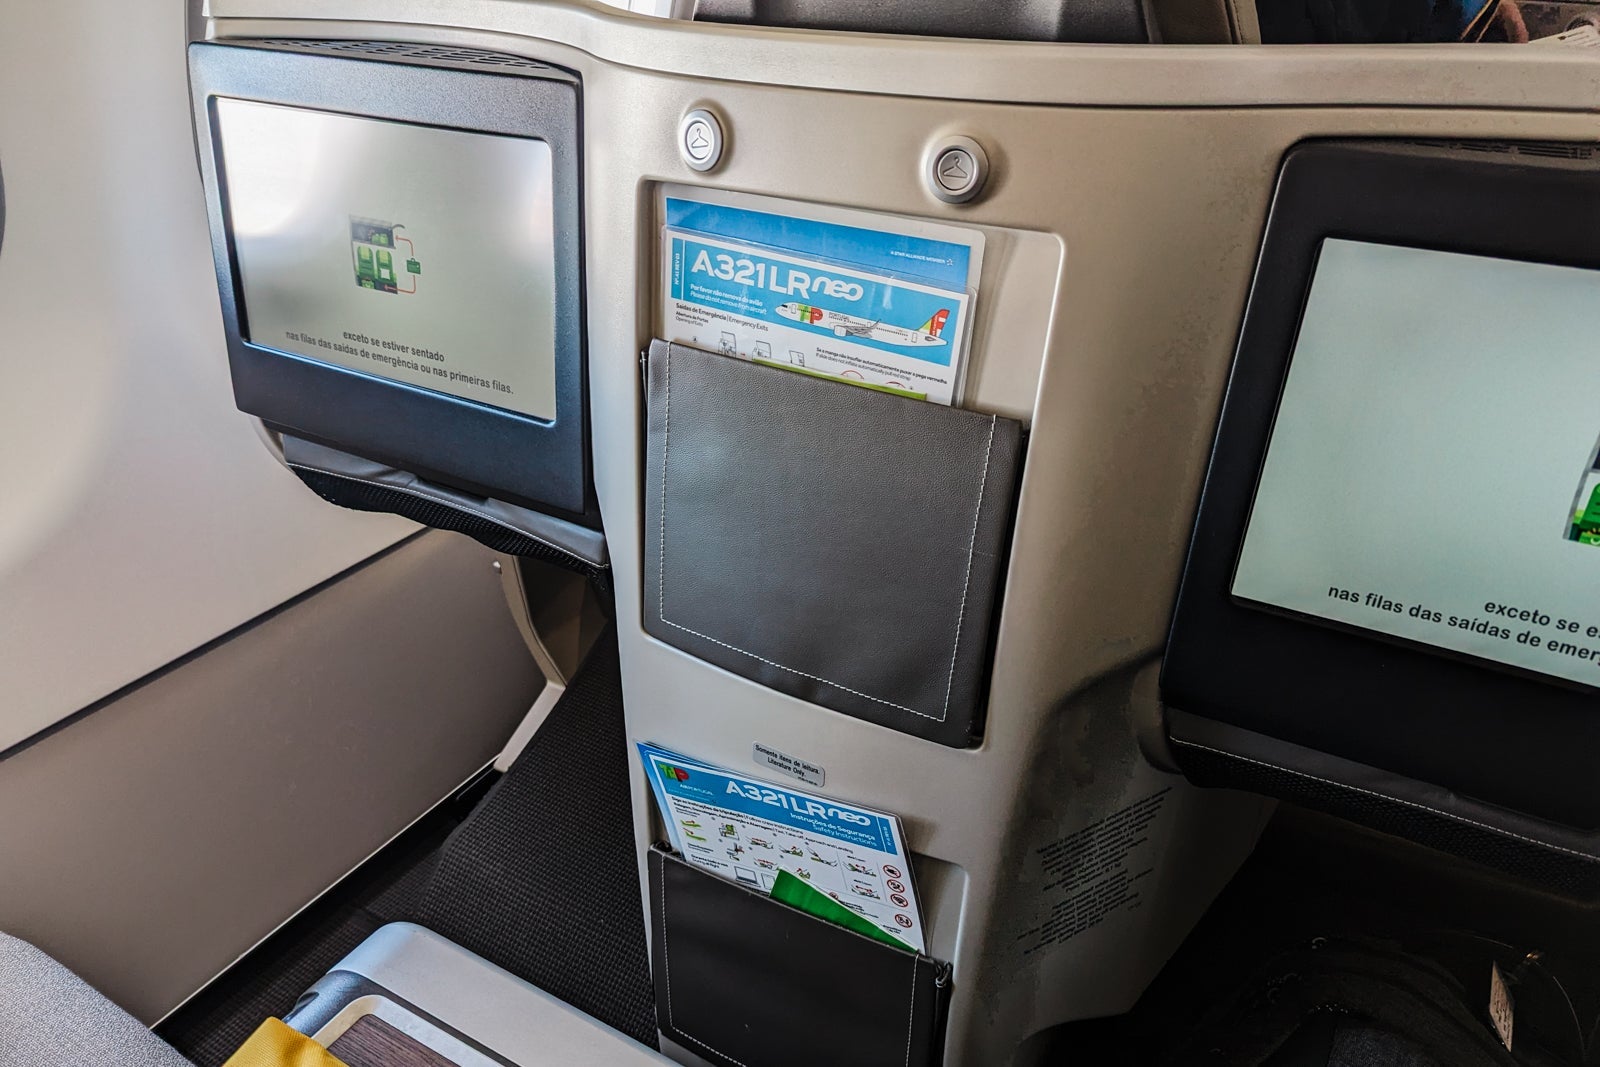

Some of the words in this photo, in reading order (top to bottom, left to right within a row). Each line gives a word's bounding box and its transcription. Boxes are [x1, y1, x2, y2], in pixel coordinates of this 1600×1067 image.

[699, 285, 712, 293] favor
[728, 315, 756, 329] Emergency
[756, 322, 768, 332] Exits
[343, 331, 369, 344] exceto
[370, 339, 380, 347] se
[382, 340, 409, 354] estiver
[411, 347, 445, 362] sentado
[286, 331, 299, 341] nas
[300, 333, 316, 345] filas
[318, 338, 332, 349] das
[360, 349, 370, 358] de
[371, 352, 419, 370] emergência
[420, 364, 431, 374] ou
[433, 367, 448, 378] nas
[450, 371, 491, 388] primeiras
[492, 379, 513, 394] filas.
[1328, 587, 1360, 603] nas
[1365, 592, 1403, 613] filas
[1408, 604, 1442, 623] das
[1447, 615, 1511, 640] saídas
[1516, 630, 1541, 647] de
[1547, 640, 1600, 666] emer
[1484, 601, 1551, 626] exceto
[1556, 618, 1580, 633] se
[1586, 625, 1600, 640] e
[755, 744, 778, 758] Somente
[779, 754, 792, 764] itens
[767, 756, 792, 771] Literature
[659, 763, 690, 782] TAP
[813, 824, 835, 836] Safety
[836, 825, 876, 841] Segurança
